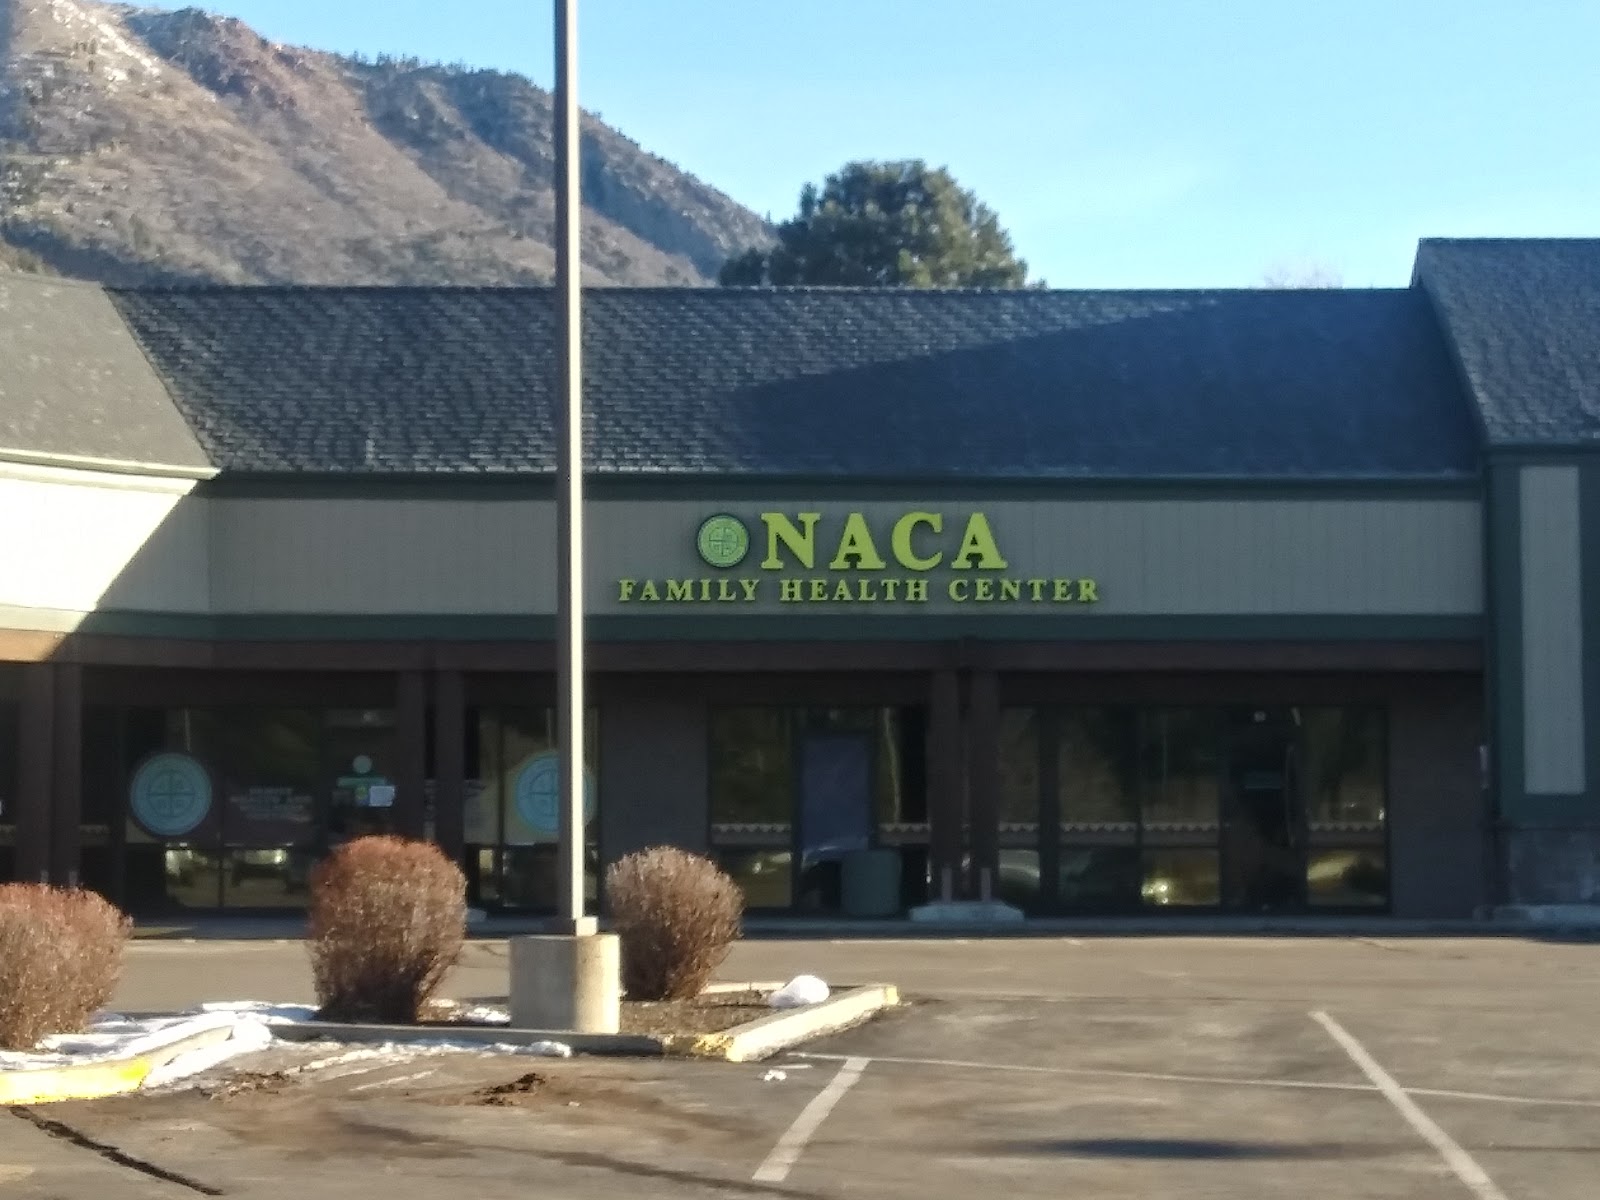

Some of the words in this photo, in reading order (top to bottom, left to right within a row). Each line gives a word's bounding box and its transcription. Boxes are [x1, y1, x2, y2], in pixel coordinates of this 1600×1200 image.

[761, 512, 1008, 571] NACA
[619, 579, 758, 602] FAMILY
[780, 579, 929, 602] HEALTH
[948, 578, 1099, 602] CENTER
